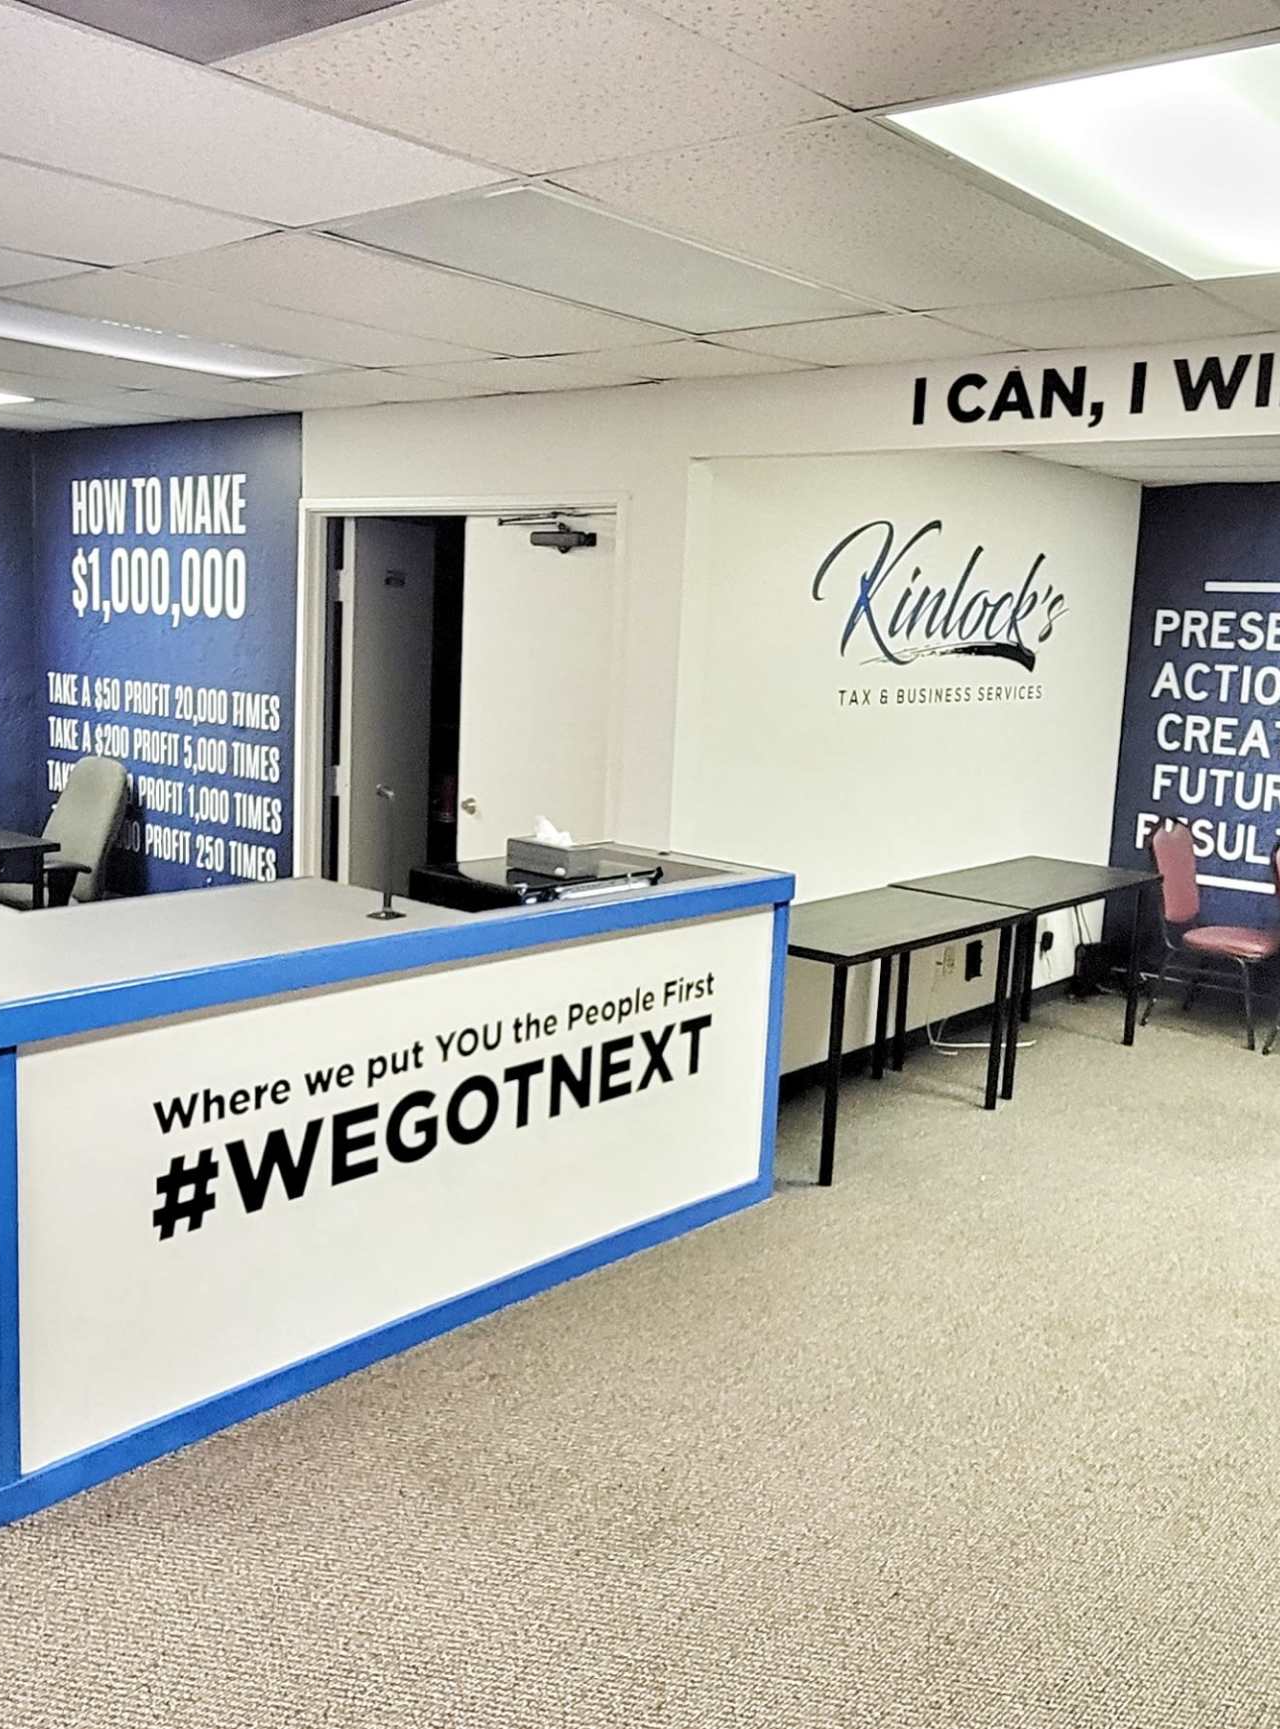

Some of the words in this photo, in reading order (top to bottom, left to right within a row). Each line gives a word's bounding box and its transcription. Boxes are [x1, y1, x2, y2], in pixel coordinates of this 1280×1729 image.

[912, 377, 927, 426] I
[946, 365, 1106, 429] CAN,
[1128, 362, 1148, 415] I
[72, 478, 127, 534] HOW
[133, 477, 161, 534] TO
[170, 473, 246, 534] MAKE
[72, 547, 246, 627] $1,000,000
[812, 520, 1070, 668] Kinlock's
[47, 672, 78, 706] TAKE
[81, 676, 91, 707] A
[95, 677, 120, 713] $50
[125, 680, 170, 717] PROFIT
[175, 685, 227, 726] 20,000
[232, 691, 280, 731] TIMES
[839, 689, 871, 706] TAX
[880, 689, 888, 704] &
[897, 687, 971, 704] BUSINESS
[978, 685, 1042, 701] SERVICES
[48, 716, 78, 750] TAKE
[82, 721, 91, 752] A
[95, 723, 129, 757] $200
[133, 728, 179, 767] PROFIT
[184, 735, 227, 775] 5,000
[232, 741, 280, 783] TIMES
[138, 776, 184, 815] PROFIT
[188, 785, 230, 825] 1,000
[234, 792, 282, 834] TIMES
[145, 824, 191, 865] PROFIT
[196, 829, 225, 872] 250
[229, 841, 276, 882] TIMES
[153, 1077, 291, 1134] Where
[304, 1062, 355, 1097] we
[367, 1041, 425, 1087] put
[436, 1021, 503, 1062] YOU
[513, 1008, 557, 1044] the
[567, 986, 655, 1030] People
[663, 972, 714, 1009] First
[153, 1014, 713, 1241] #WEGOTNEXT
